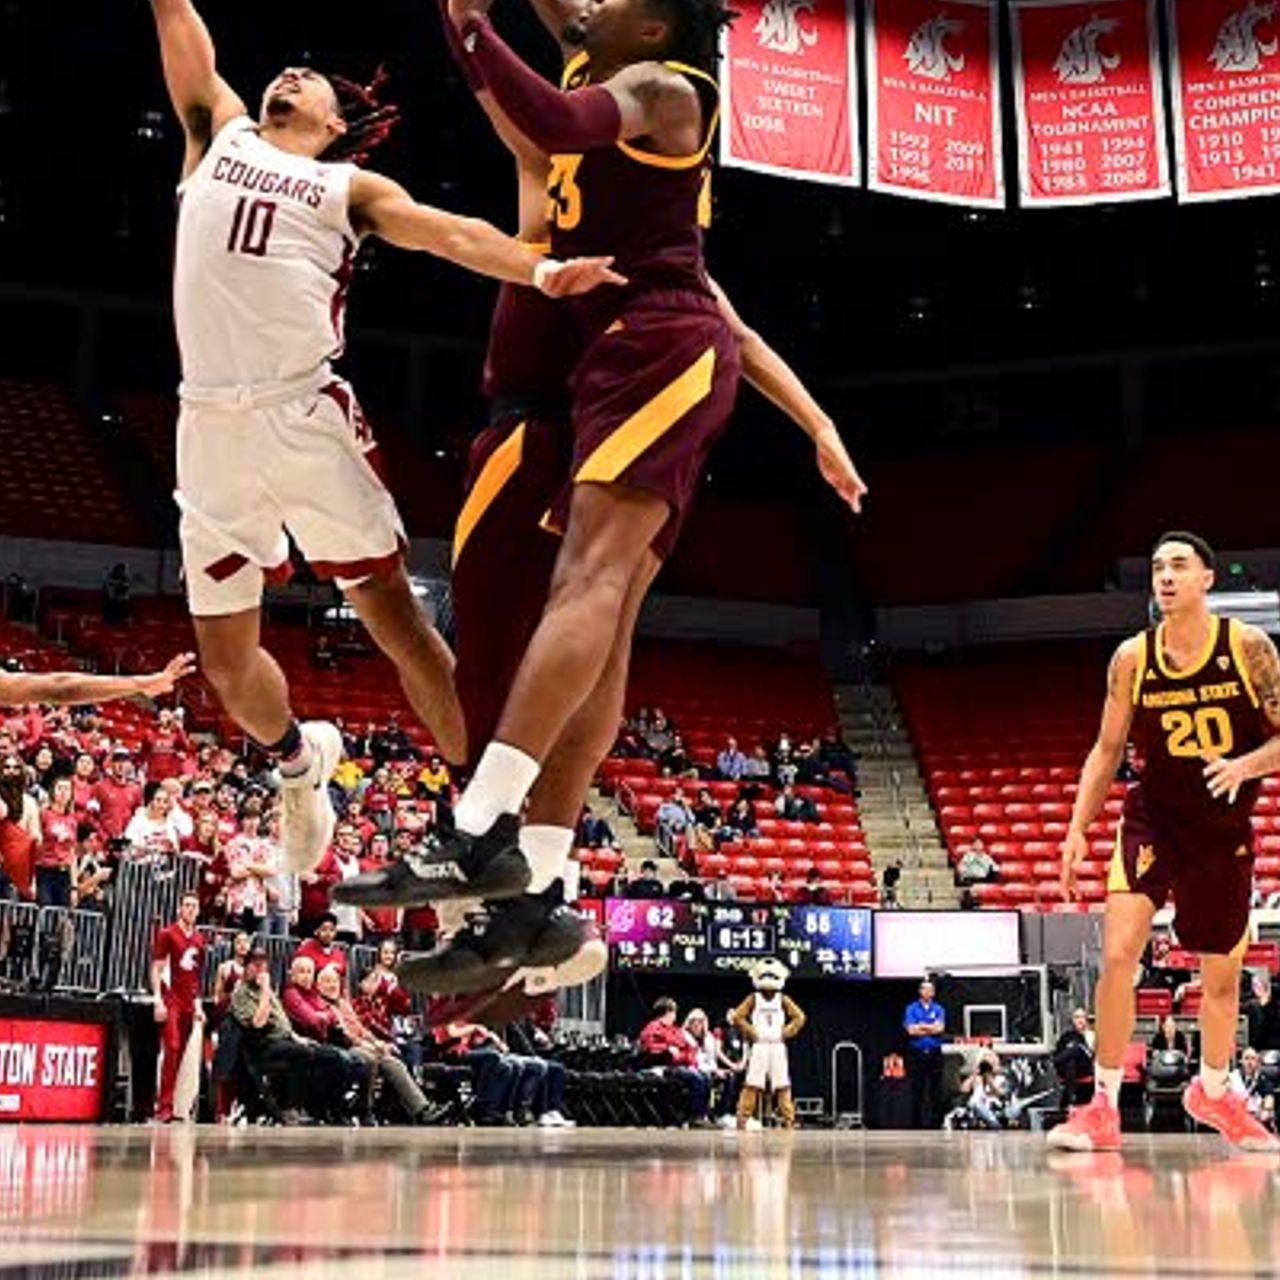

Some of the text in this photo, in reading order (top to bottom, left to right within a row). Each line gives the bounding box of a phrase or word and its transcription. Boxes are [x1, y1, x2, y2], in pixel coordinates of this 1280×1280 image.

[913, 102, 959, 128] NIT
[1061, 99, 1118, 120] NCAA
[1032, 116, 1150, 137] TOURNAMENT
[212, 156, 326, 207] COUGARS
[227, 195, 278, 257] 10
[1199, 680, 1240, 702] STATE
[1161, 706, 1233, 758] 20
[646, 905, 675, 930] 62
[720, 927, 766, 950] 6:13
[41, 1044, 98, 1087] STATE
